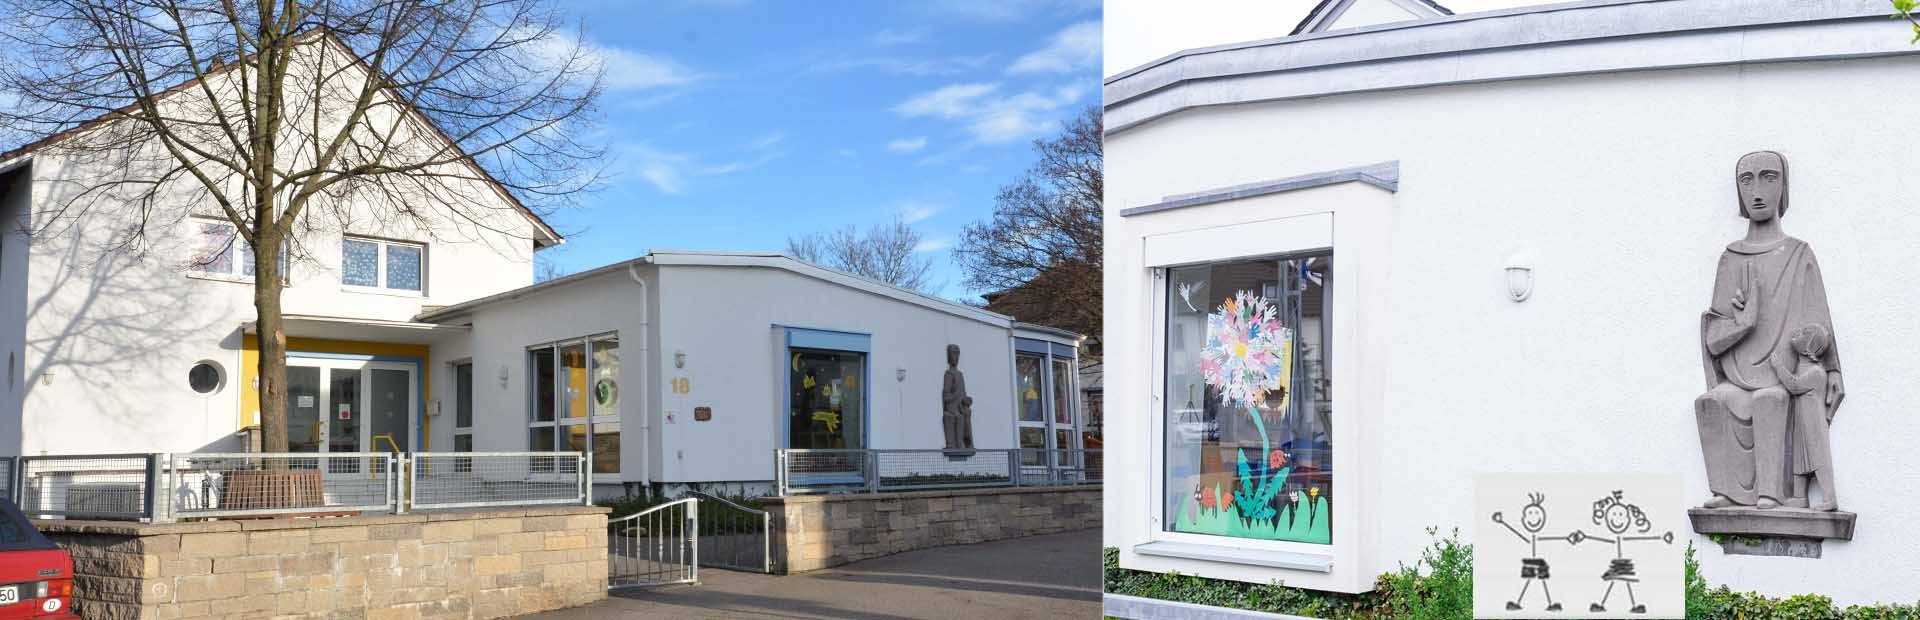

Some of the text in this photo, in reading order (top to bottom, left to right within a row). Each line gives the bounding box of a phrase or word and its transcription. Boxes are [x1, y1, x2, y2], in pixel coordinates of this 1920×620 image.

[671, 377, 689, 394] 18
[0, 589, 15, 602] 50
[48, 600, 56, 610] D
